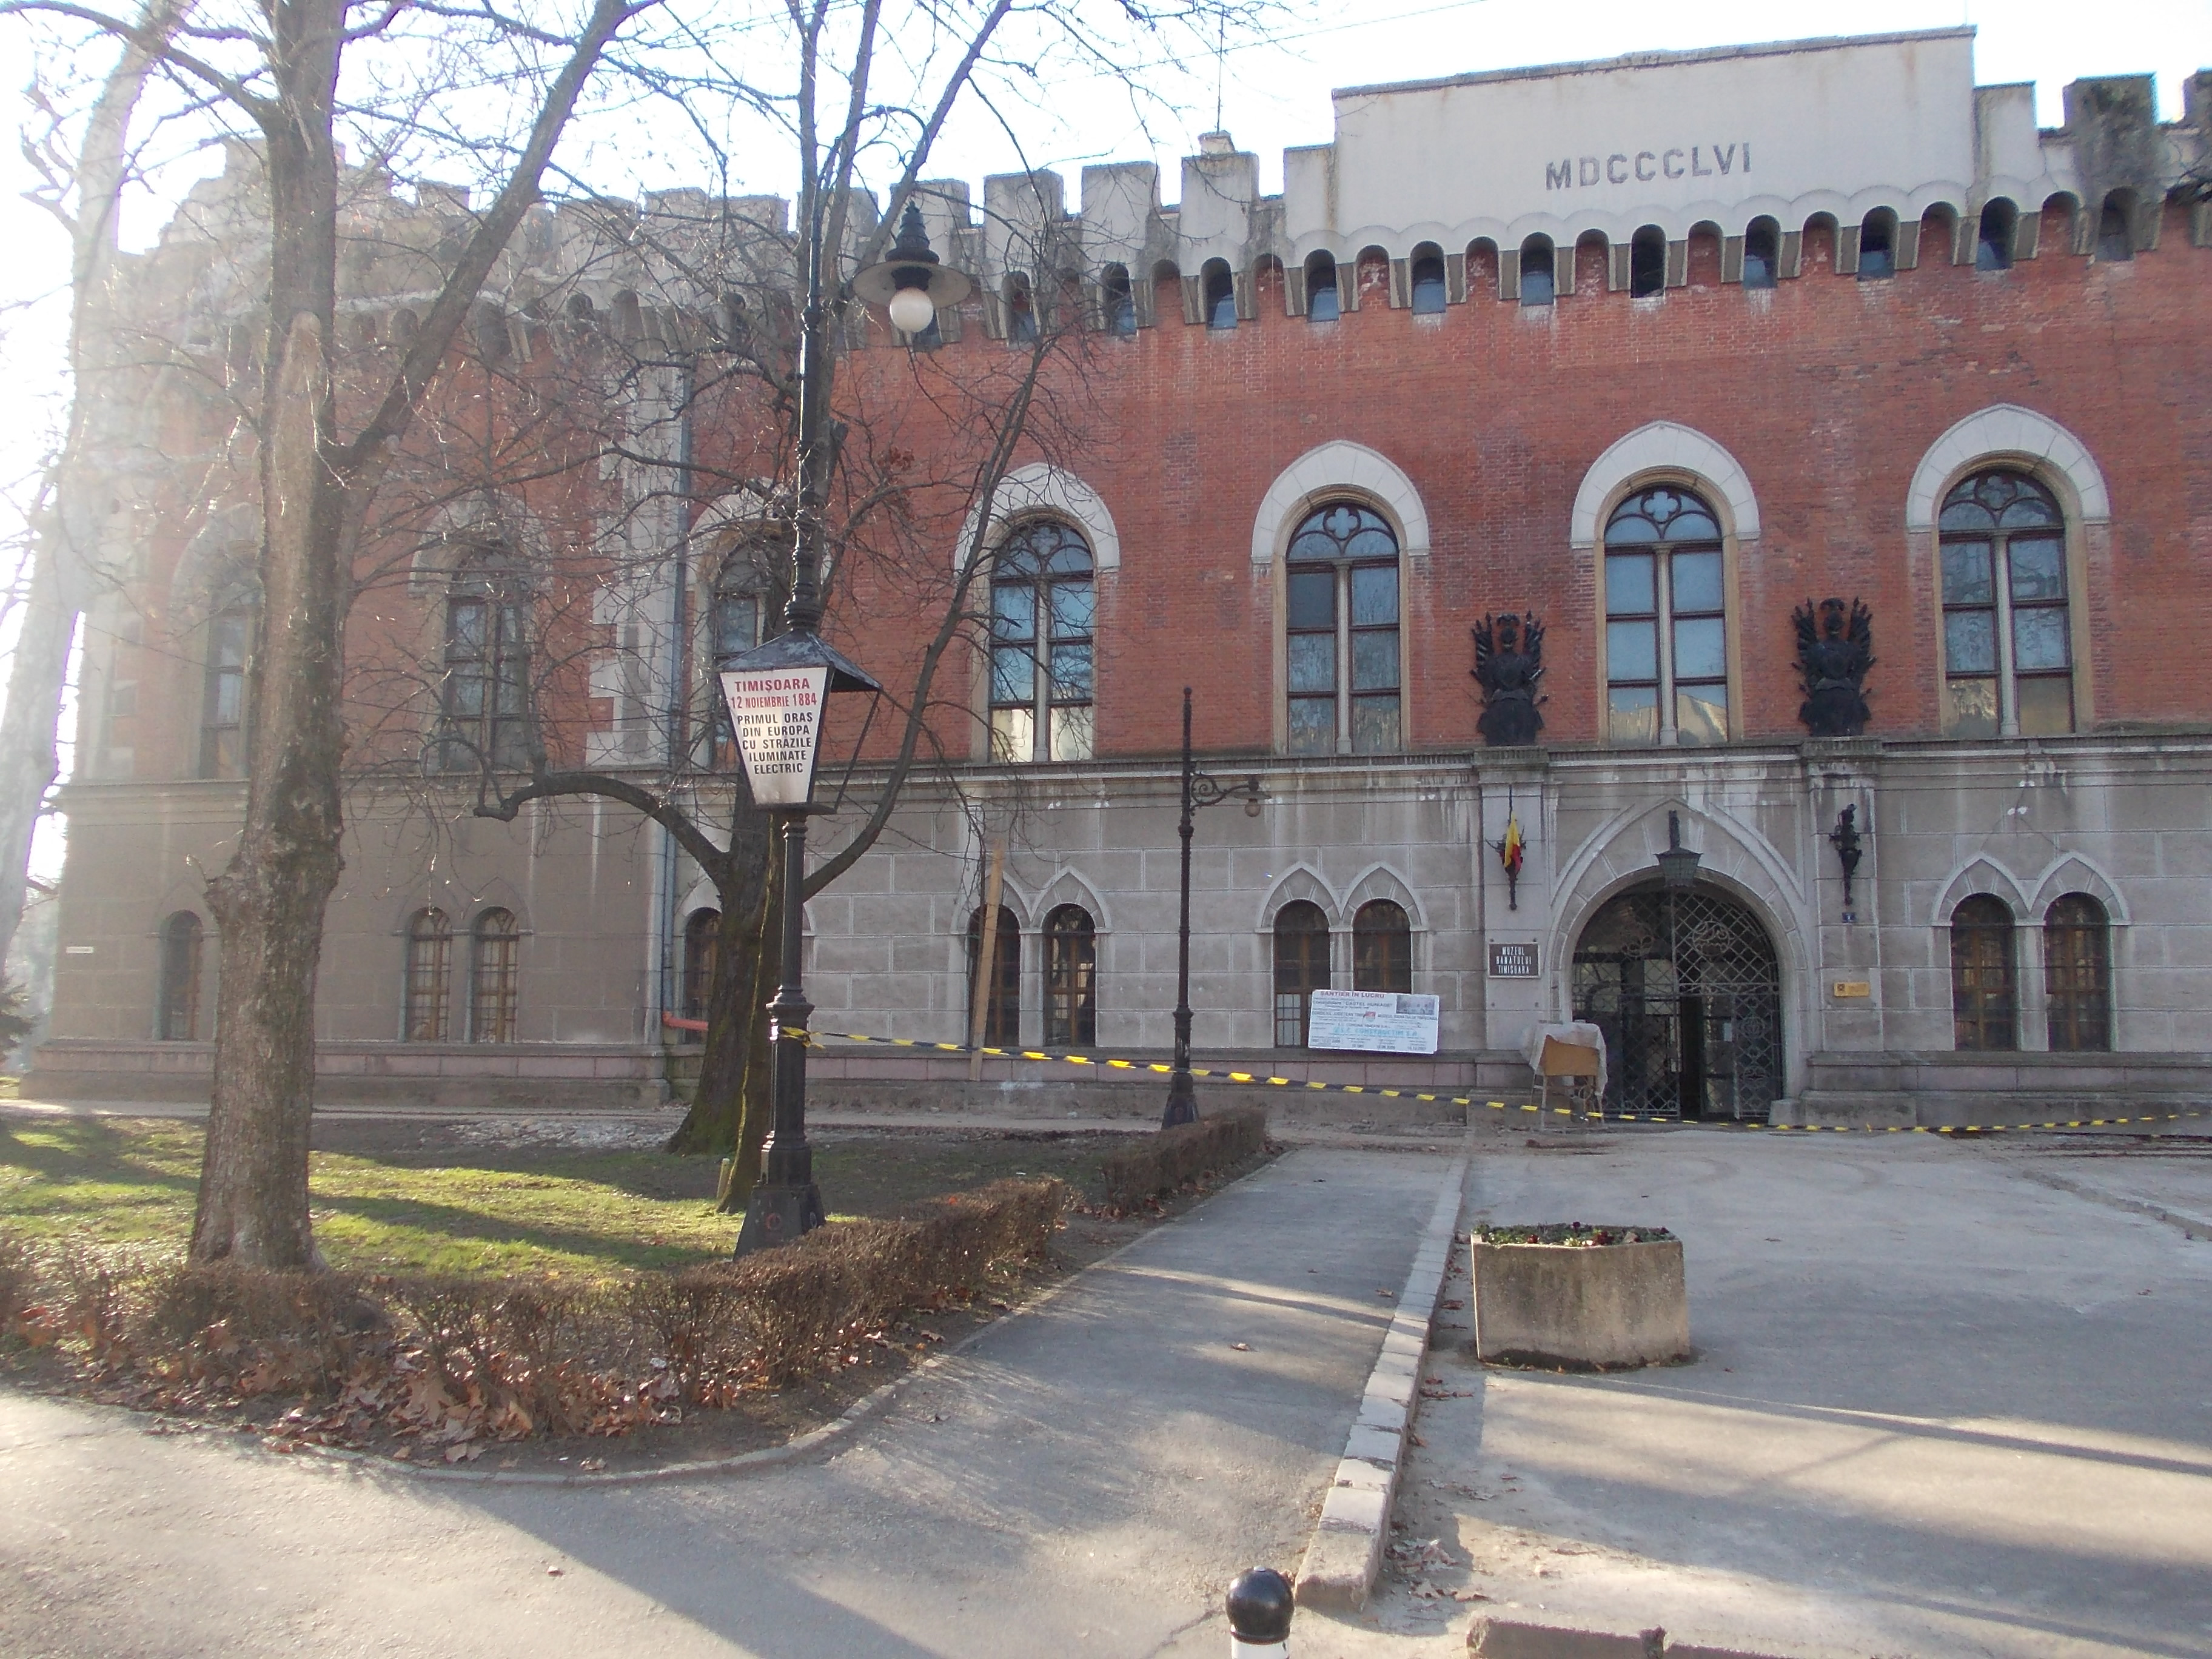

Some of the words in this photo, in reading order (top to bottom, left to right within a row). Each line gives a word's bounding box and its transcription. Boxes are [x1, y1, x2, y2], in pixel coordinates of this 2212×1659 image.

[1546, 141, 1752, 191] MDCCCLVI
[731, 695, 743, 709] 12
[745, 695, 789, 708] NOIEMBRIE
[793, 692, 817, 706] 1884
[737, 714, 778, 725] PRIMUL
[743, 727, 761, 737] DIN
[768, 725, 809, 736] EUROPA
[742, 740, 756, 750] CU
[749, 750, 806, 762] ILUMINATE
[754, 763, 803, 774] ELECTRIC
[1502, 947, 1524, 956] MUZEUL
[1496, 956, 1532, 965] BANATULUI
